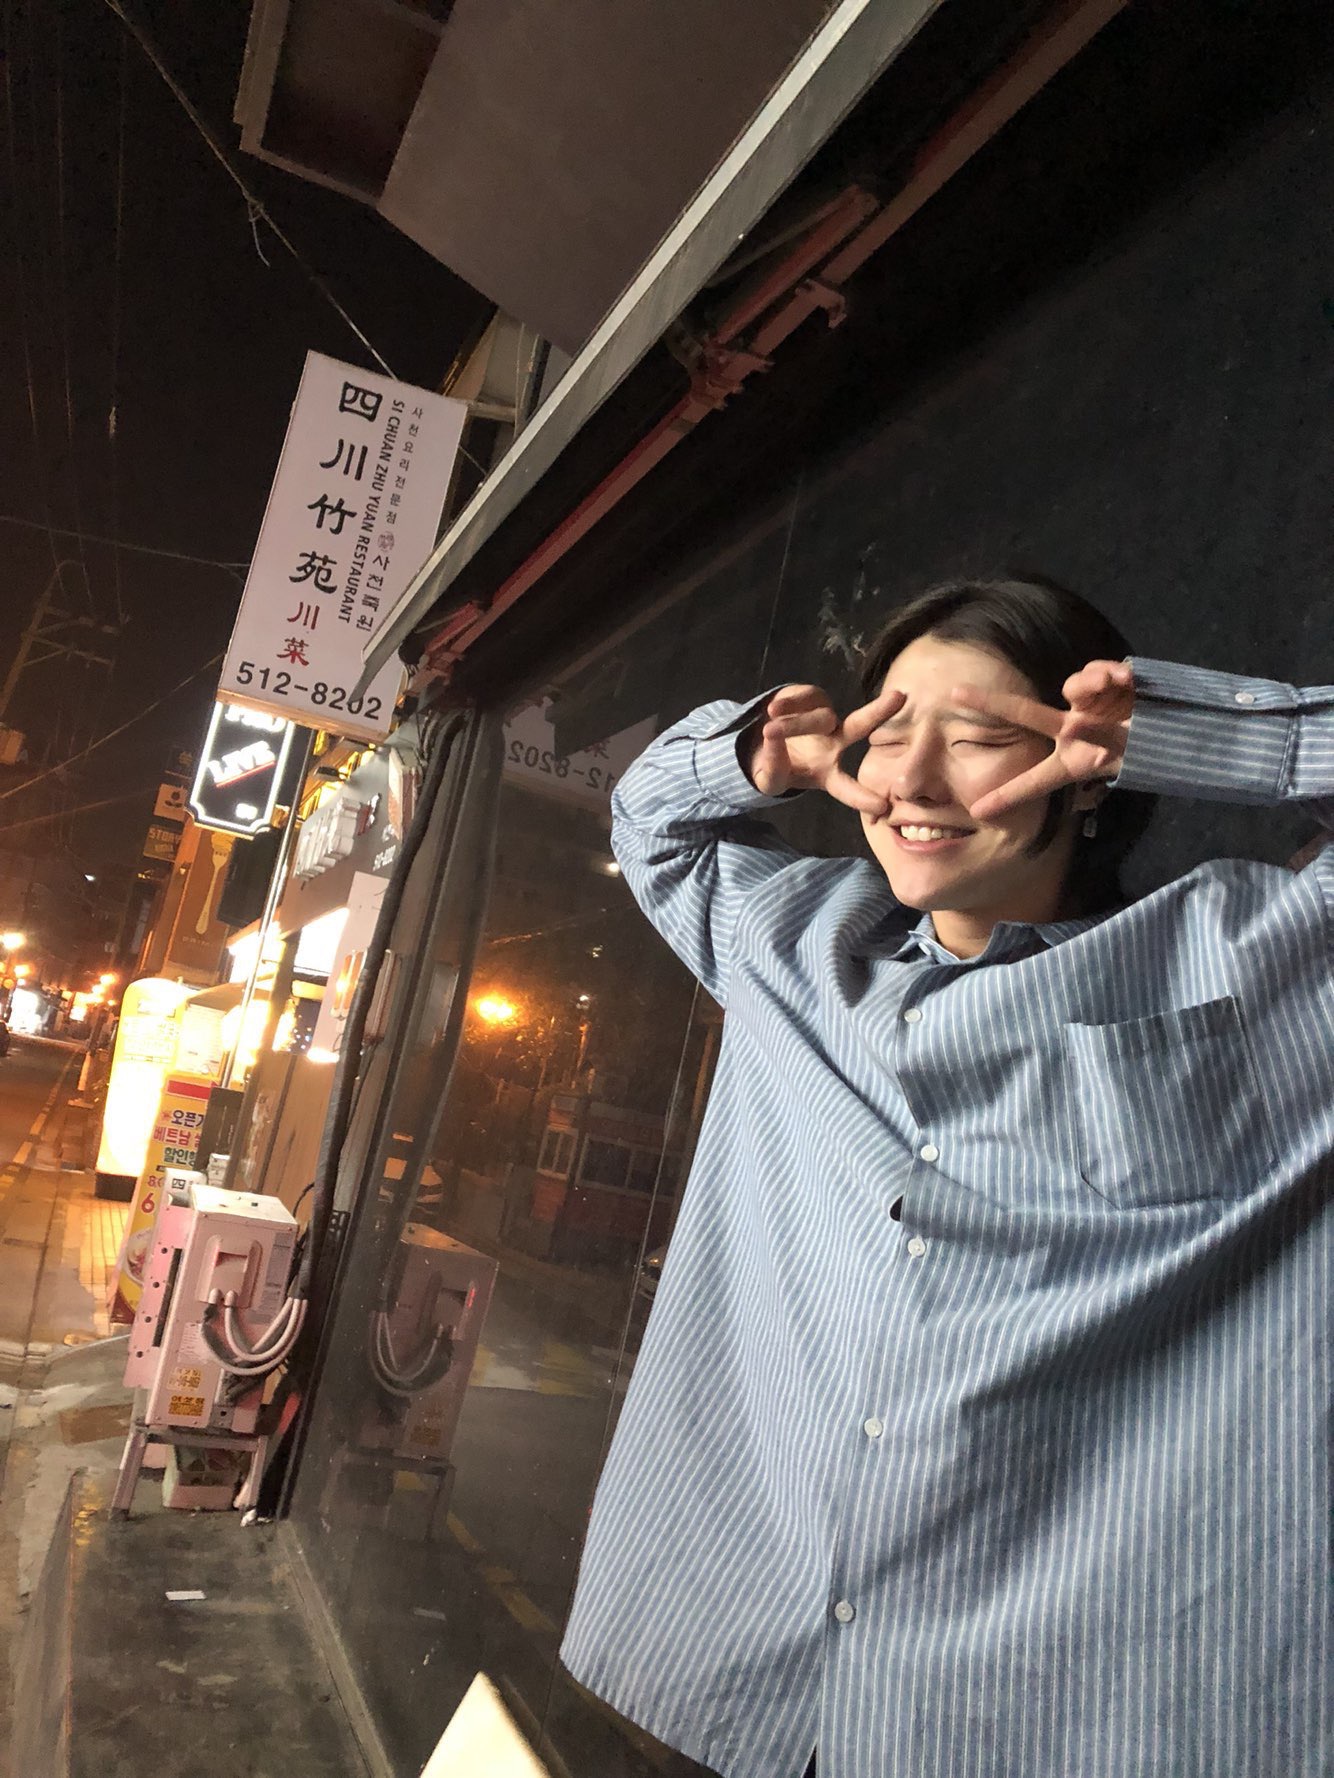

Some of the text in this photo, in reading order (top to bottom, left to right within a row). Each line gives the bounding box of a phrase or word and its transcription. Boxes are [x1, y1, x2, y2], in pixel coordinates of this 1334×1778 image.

[276, 381, 383, 667] 四川竹苑 川菜
[338, 399, 405, 623] SI CHUAN ZHU YUAN RESTAURANT
[236, 661, 383, 721] 512-8202
[153, 1126, 191, 1146] 베트남
